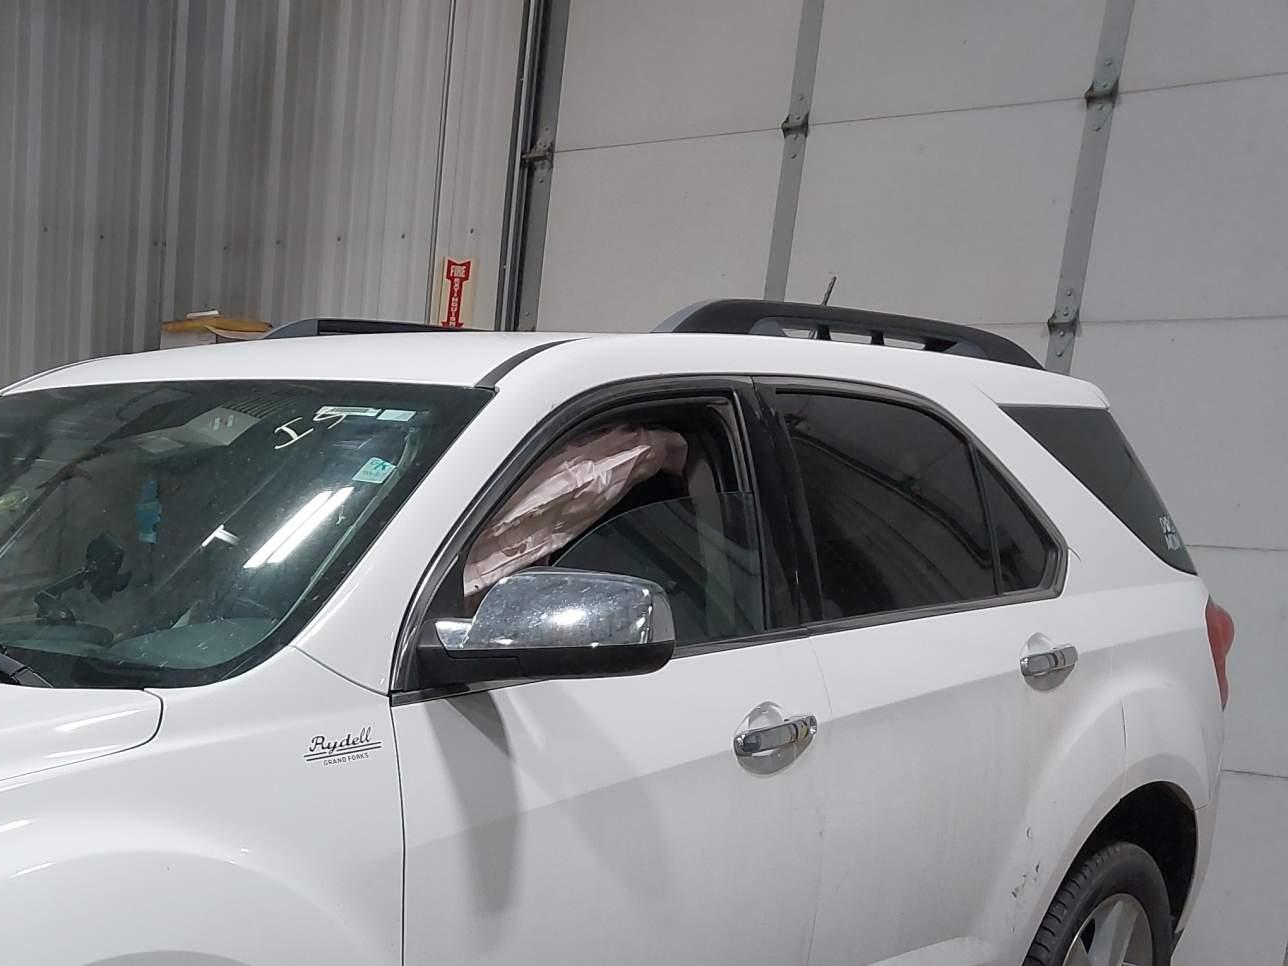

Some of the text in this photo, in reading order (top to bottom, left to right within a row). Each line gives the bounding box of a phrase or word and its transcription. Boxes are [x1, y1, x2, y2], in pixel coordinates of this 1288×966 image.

[449, 265, 467, 278] FIRE
[448, 278, 460, 328] EXTINGUISH
[309, 726, 372, 755] Rydell
[323, 752, 369, 766] GRAND FORKS
